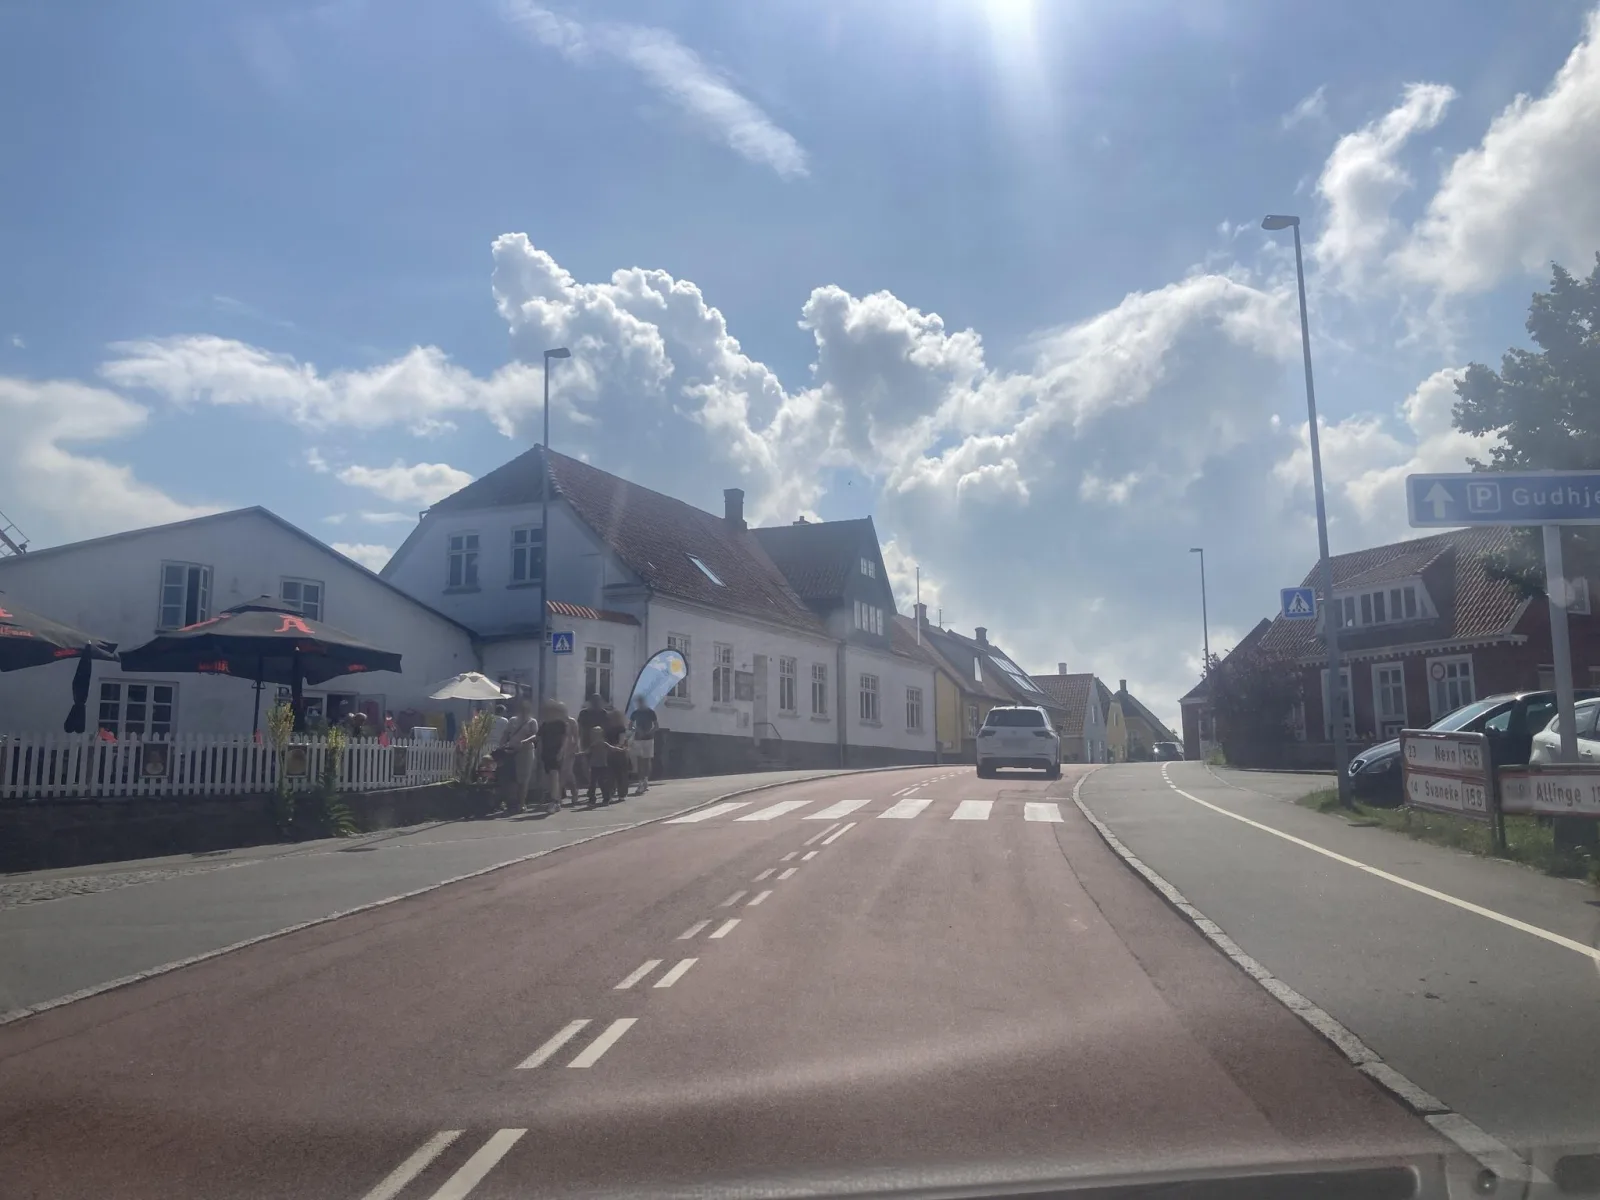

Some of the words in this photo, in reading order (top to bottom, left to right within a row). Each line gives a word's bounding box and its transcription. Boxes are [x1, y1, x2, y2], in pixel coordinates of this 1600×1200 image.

[1476, 486, 1492, 508] P
[1424, 780, 1459, 802] Svaneke
[1536, 781, 1582, 807] Allinge
